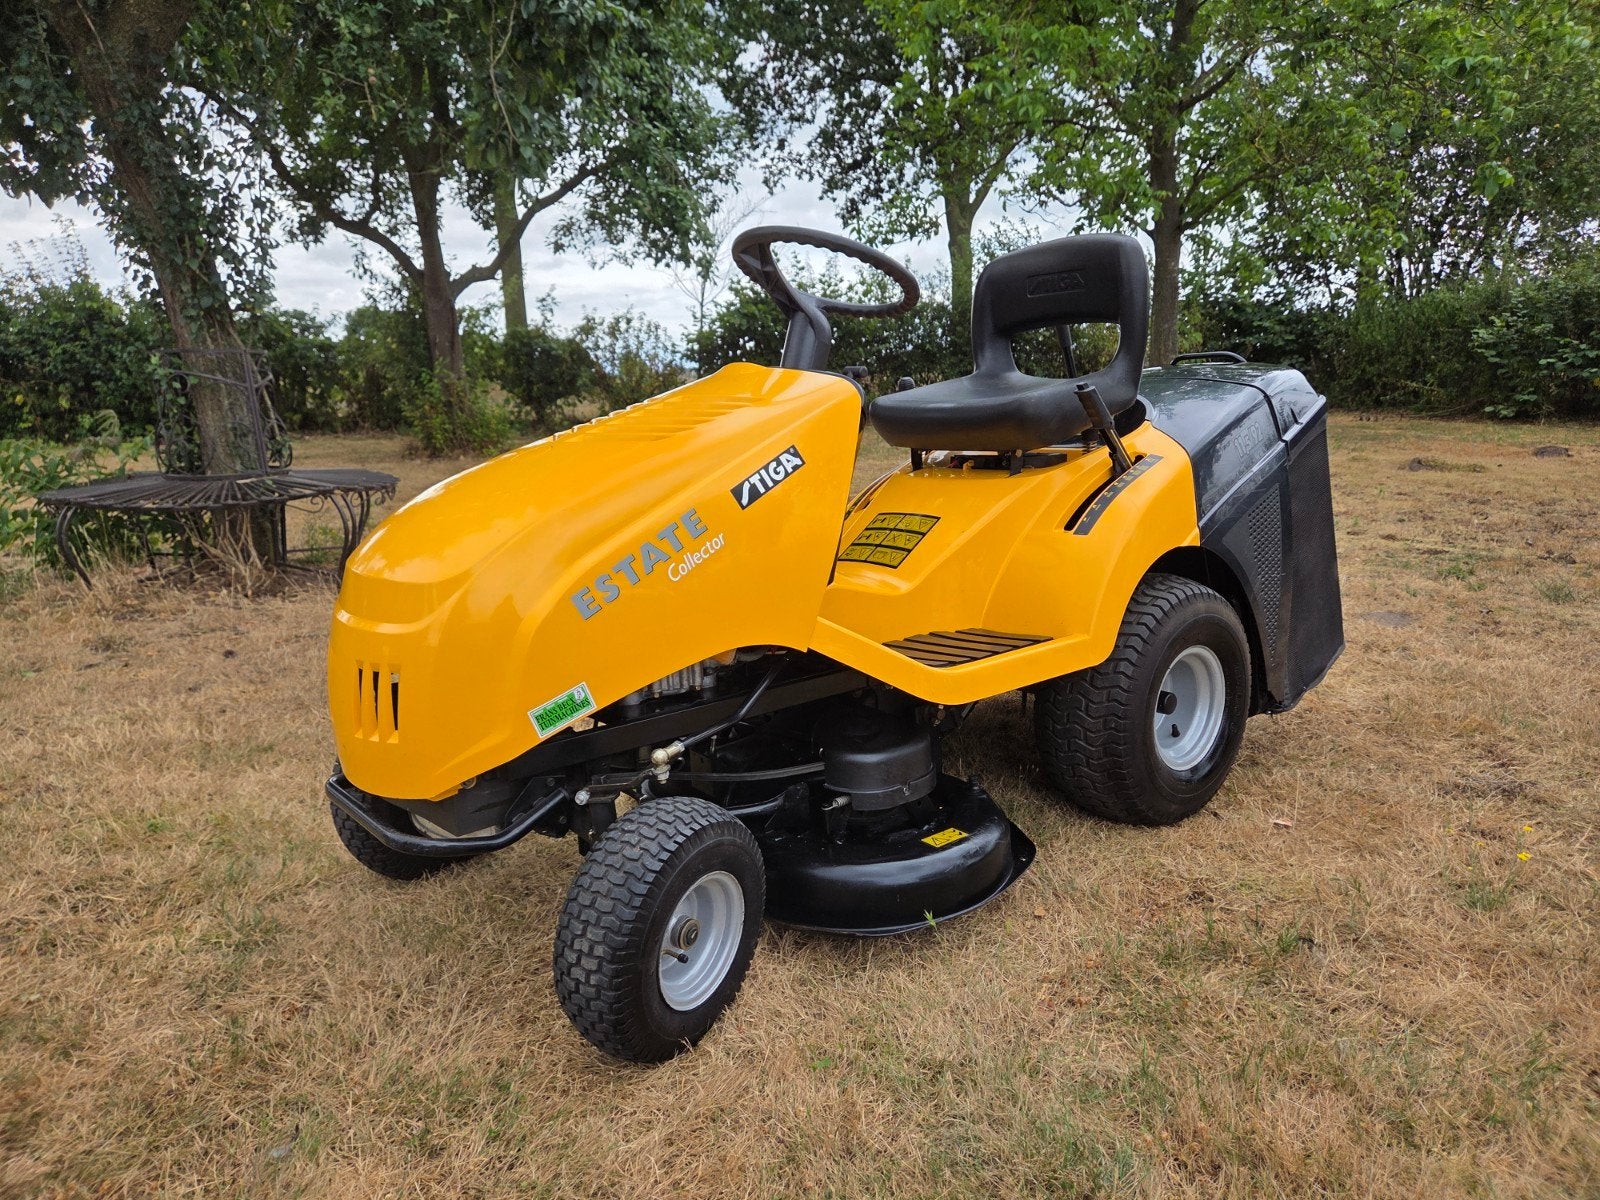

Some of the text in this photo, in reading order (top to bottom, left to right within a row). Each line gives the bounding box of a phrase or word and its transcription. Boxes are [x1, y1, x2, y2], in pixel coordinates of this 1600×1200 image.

[740, 449, 803, 507] STIGA
[570, 508, 708, 621] ESTATE
[667, 532, 725, 582] Collector
[535, 706, 558, 723] FRANS
[539, 698, 590, 731] TUINMACHINES
